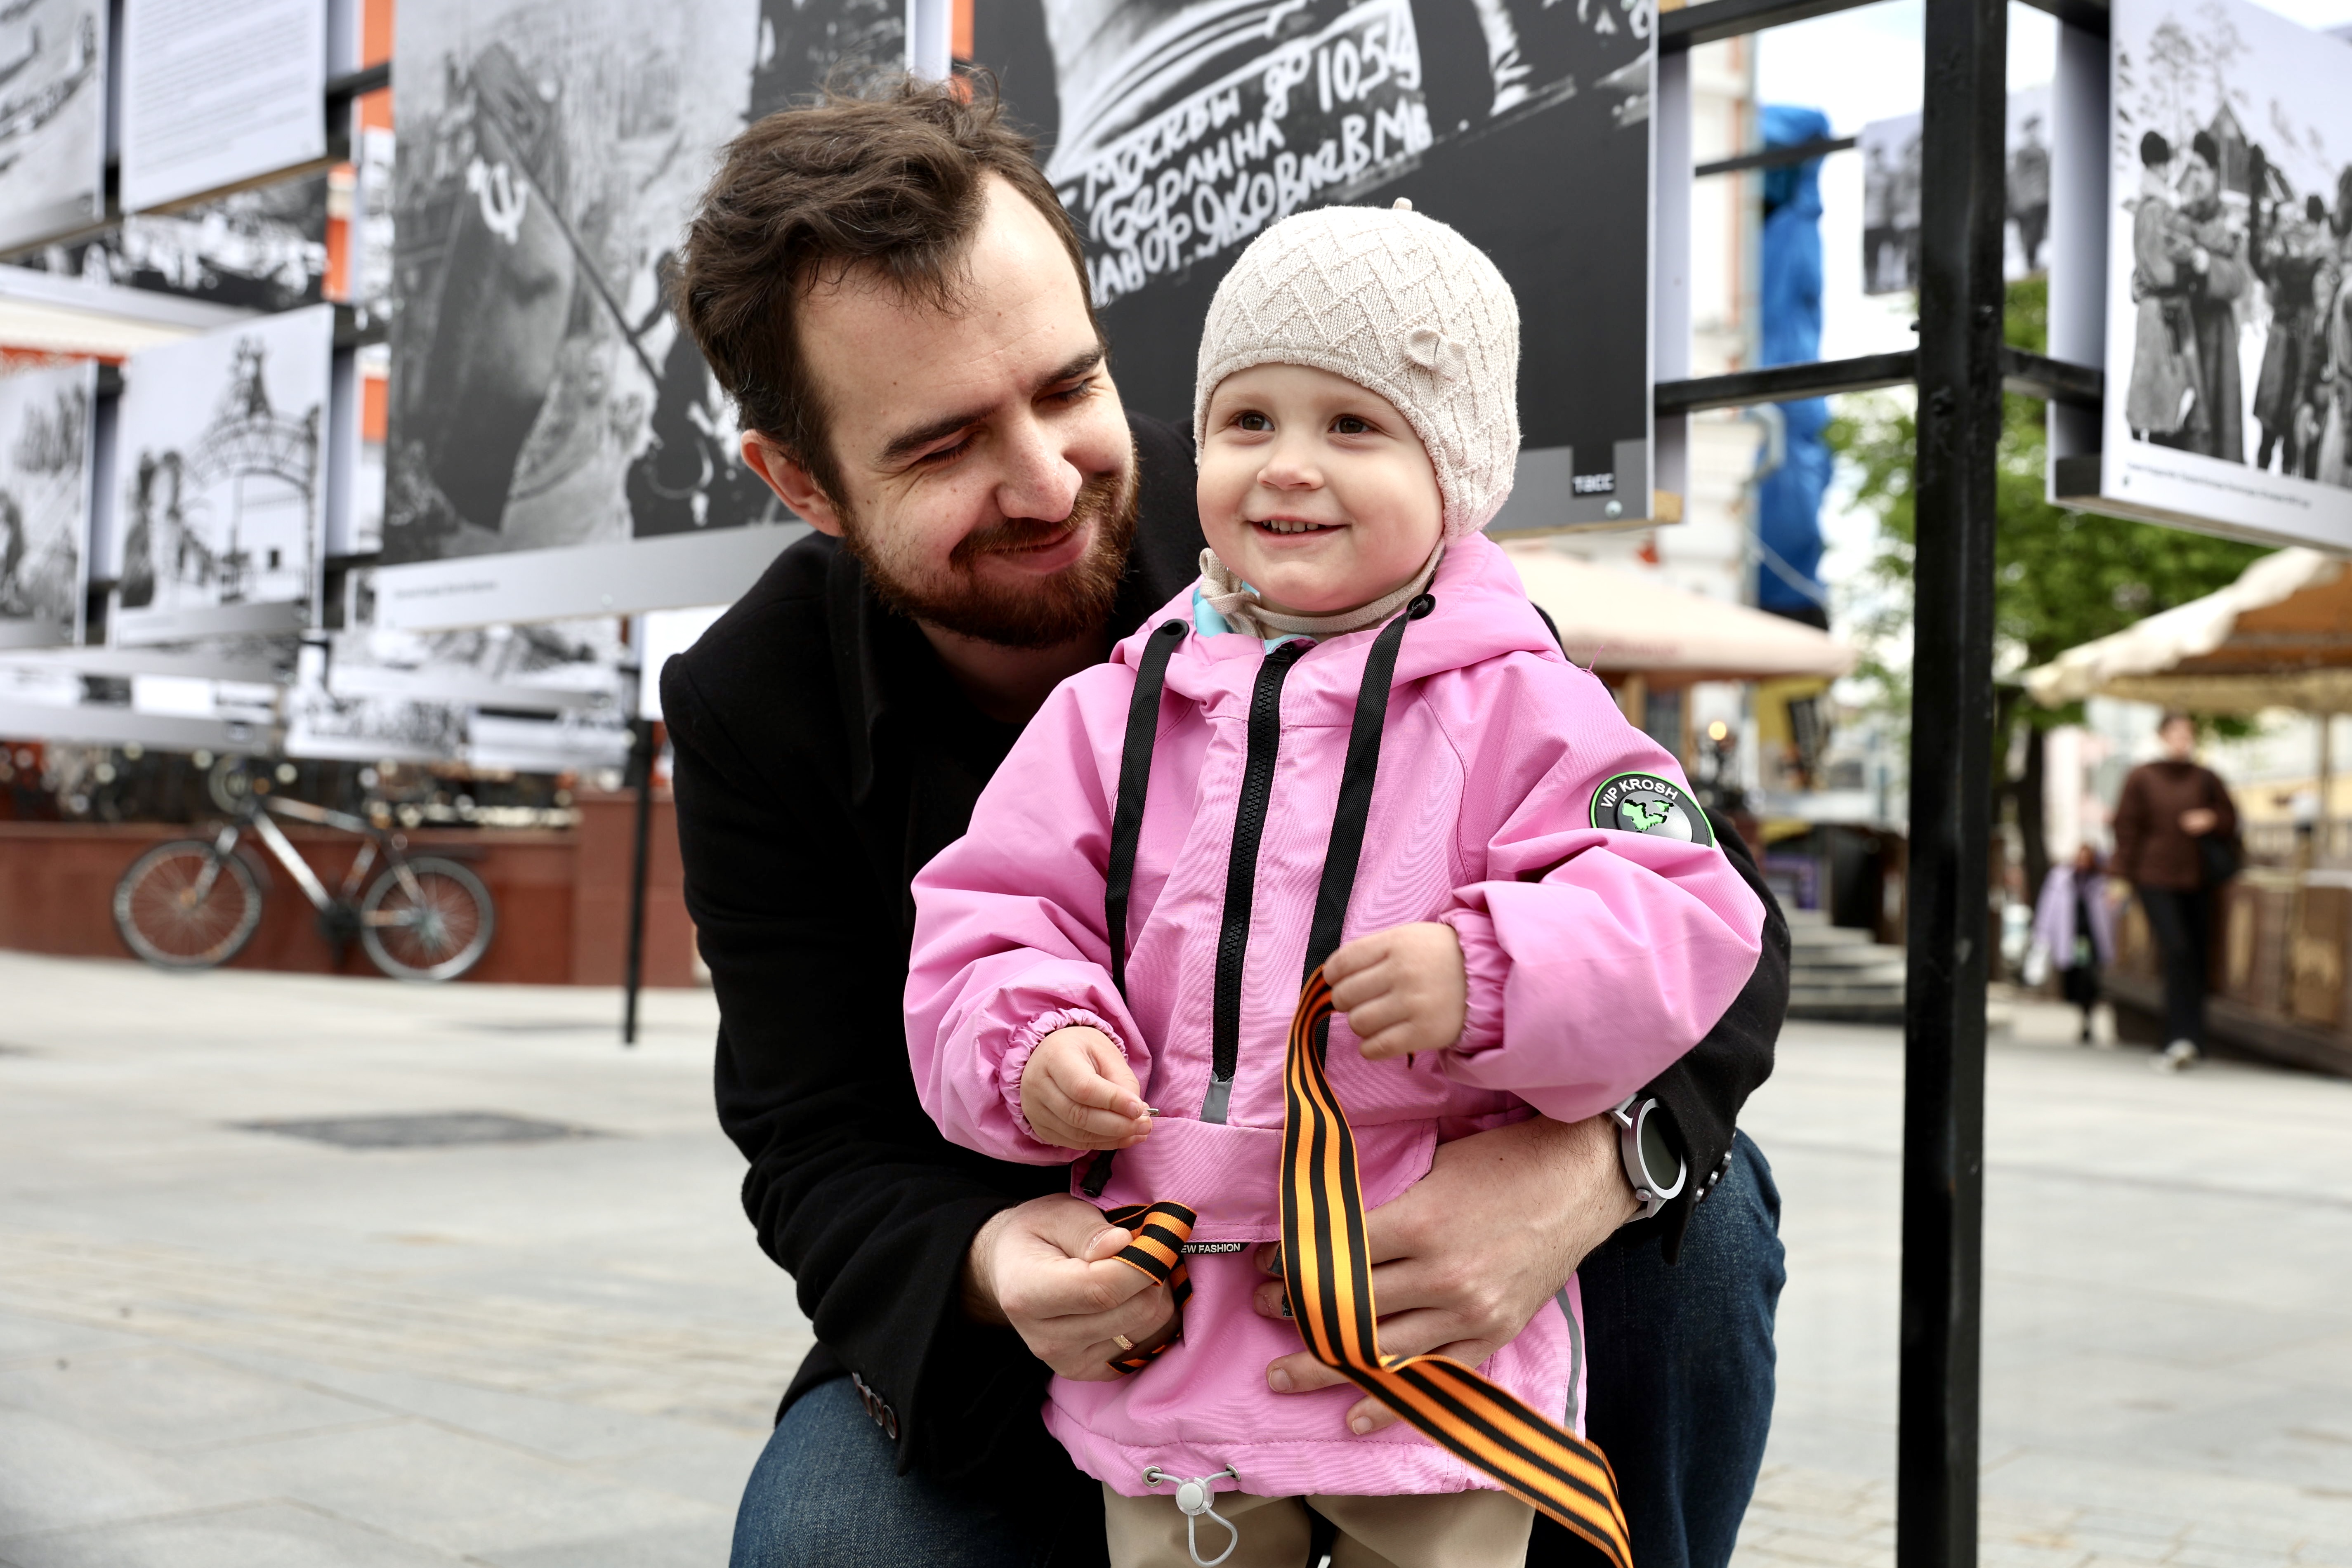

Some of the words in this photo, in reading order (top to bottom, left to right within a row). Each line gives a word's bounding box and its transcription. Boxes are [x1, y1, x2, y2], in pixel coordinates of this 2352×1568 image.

[1600, 787, 1618, 808] VIP
[1618, 779, 1678, 800] KROSH
[1181, 1245, 1196, 1253] EW
[1198, 1243, 1240, 1253] FASHION
